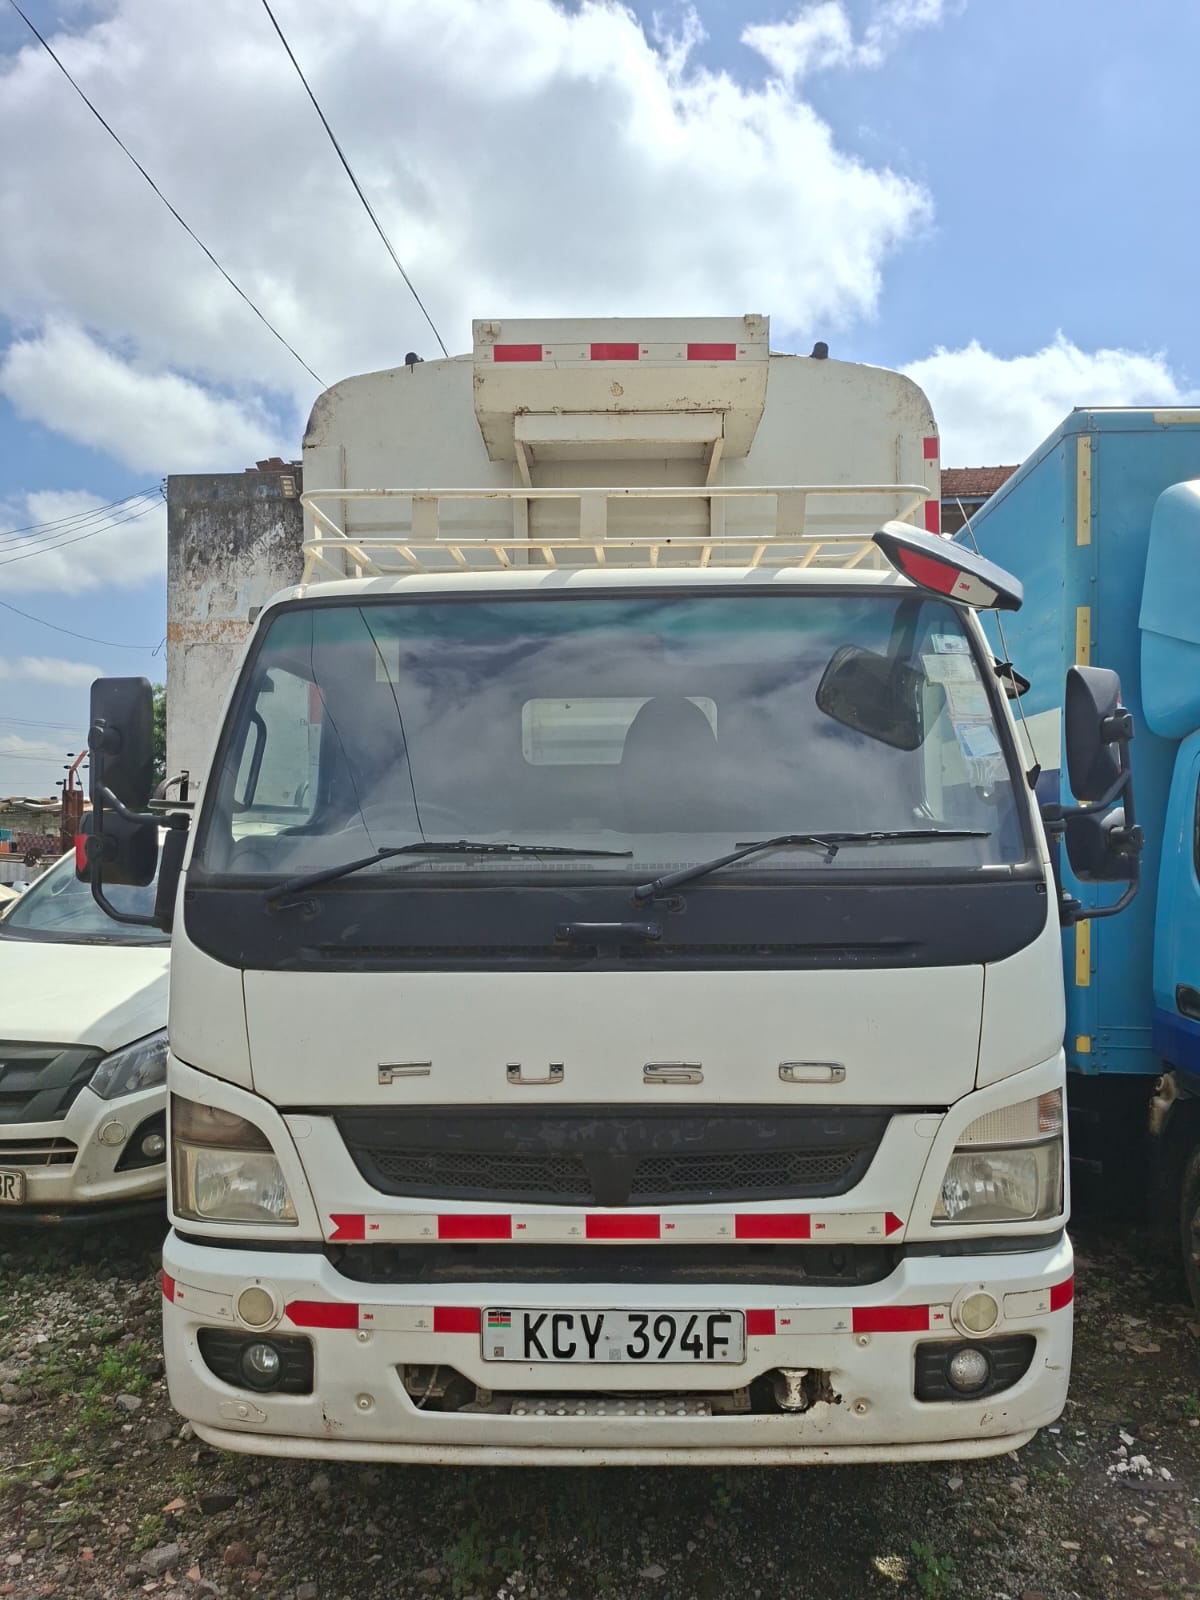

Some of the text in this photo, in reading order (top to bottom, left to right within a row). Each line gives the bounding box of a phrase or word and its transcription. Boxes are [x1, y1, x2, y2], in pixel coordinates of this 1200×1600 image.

[378, 1060, 847, 1085] FUSO
[0, 1175, 15, 1199] R
[369, 1223, 380, 1231] 3M
[515, 1223, 527, 1231] 3M
[523, 1313, 605, 1359] KCY
[626, 1314, 732, 1359] 394F
